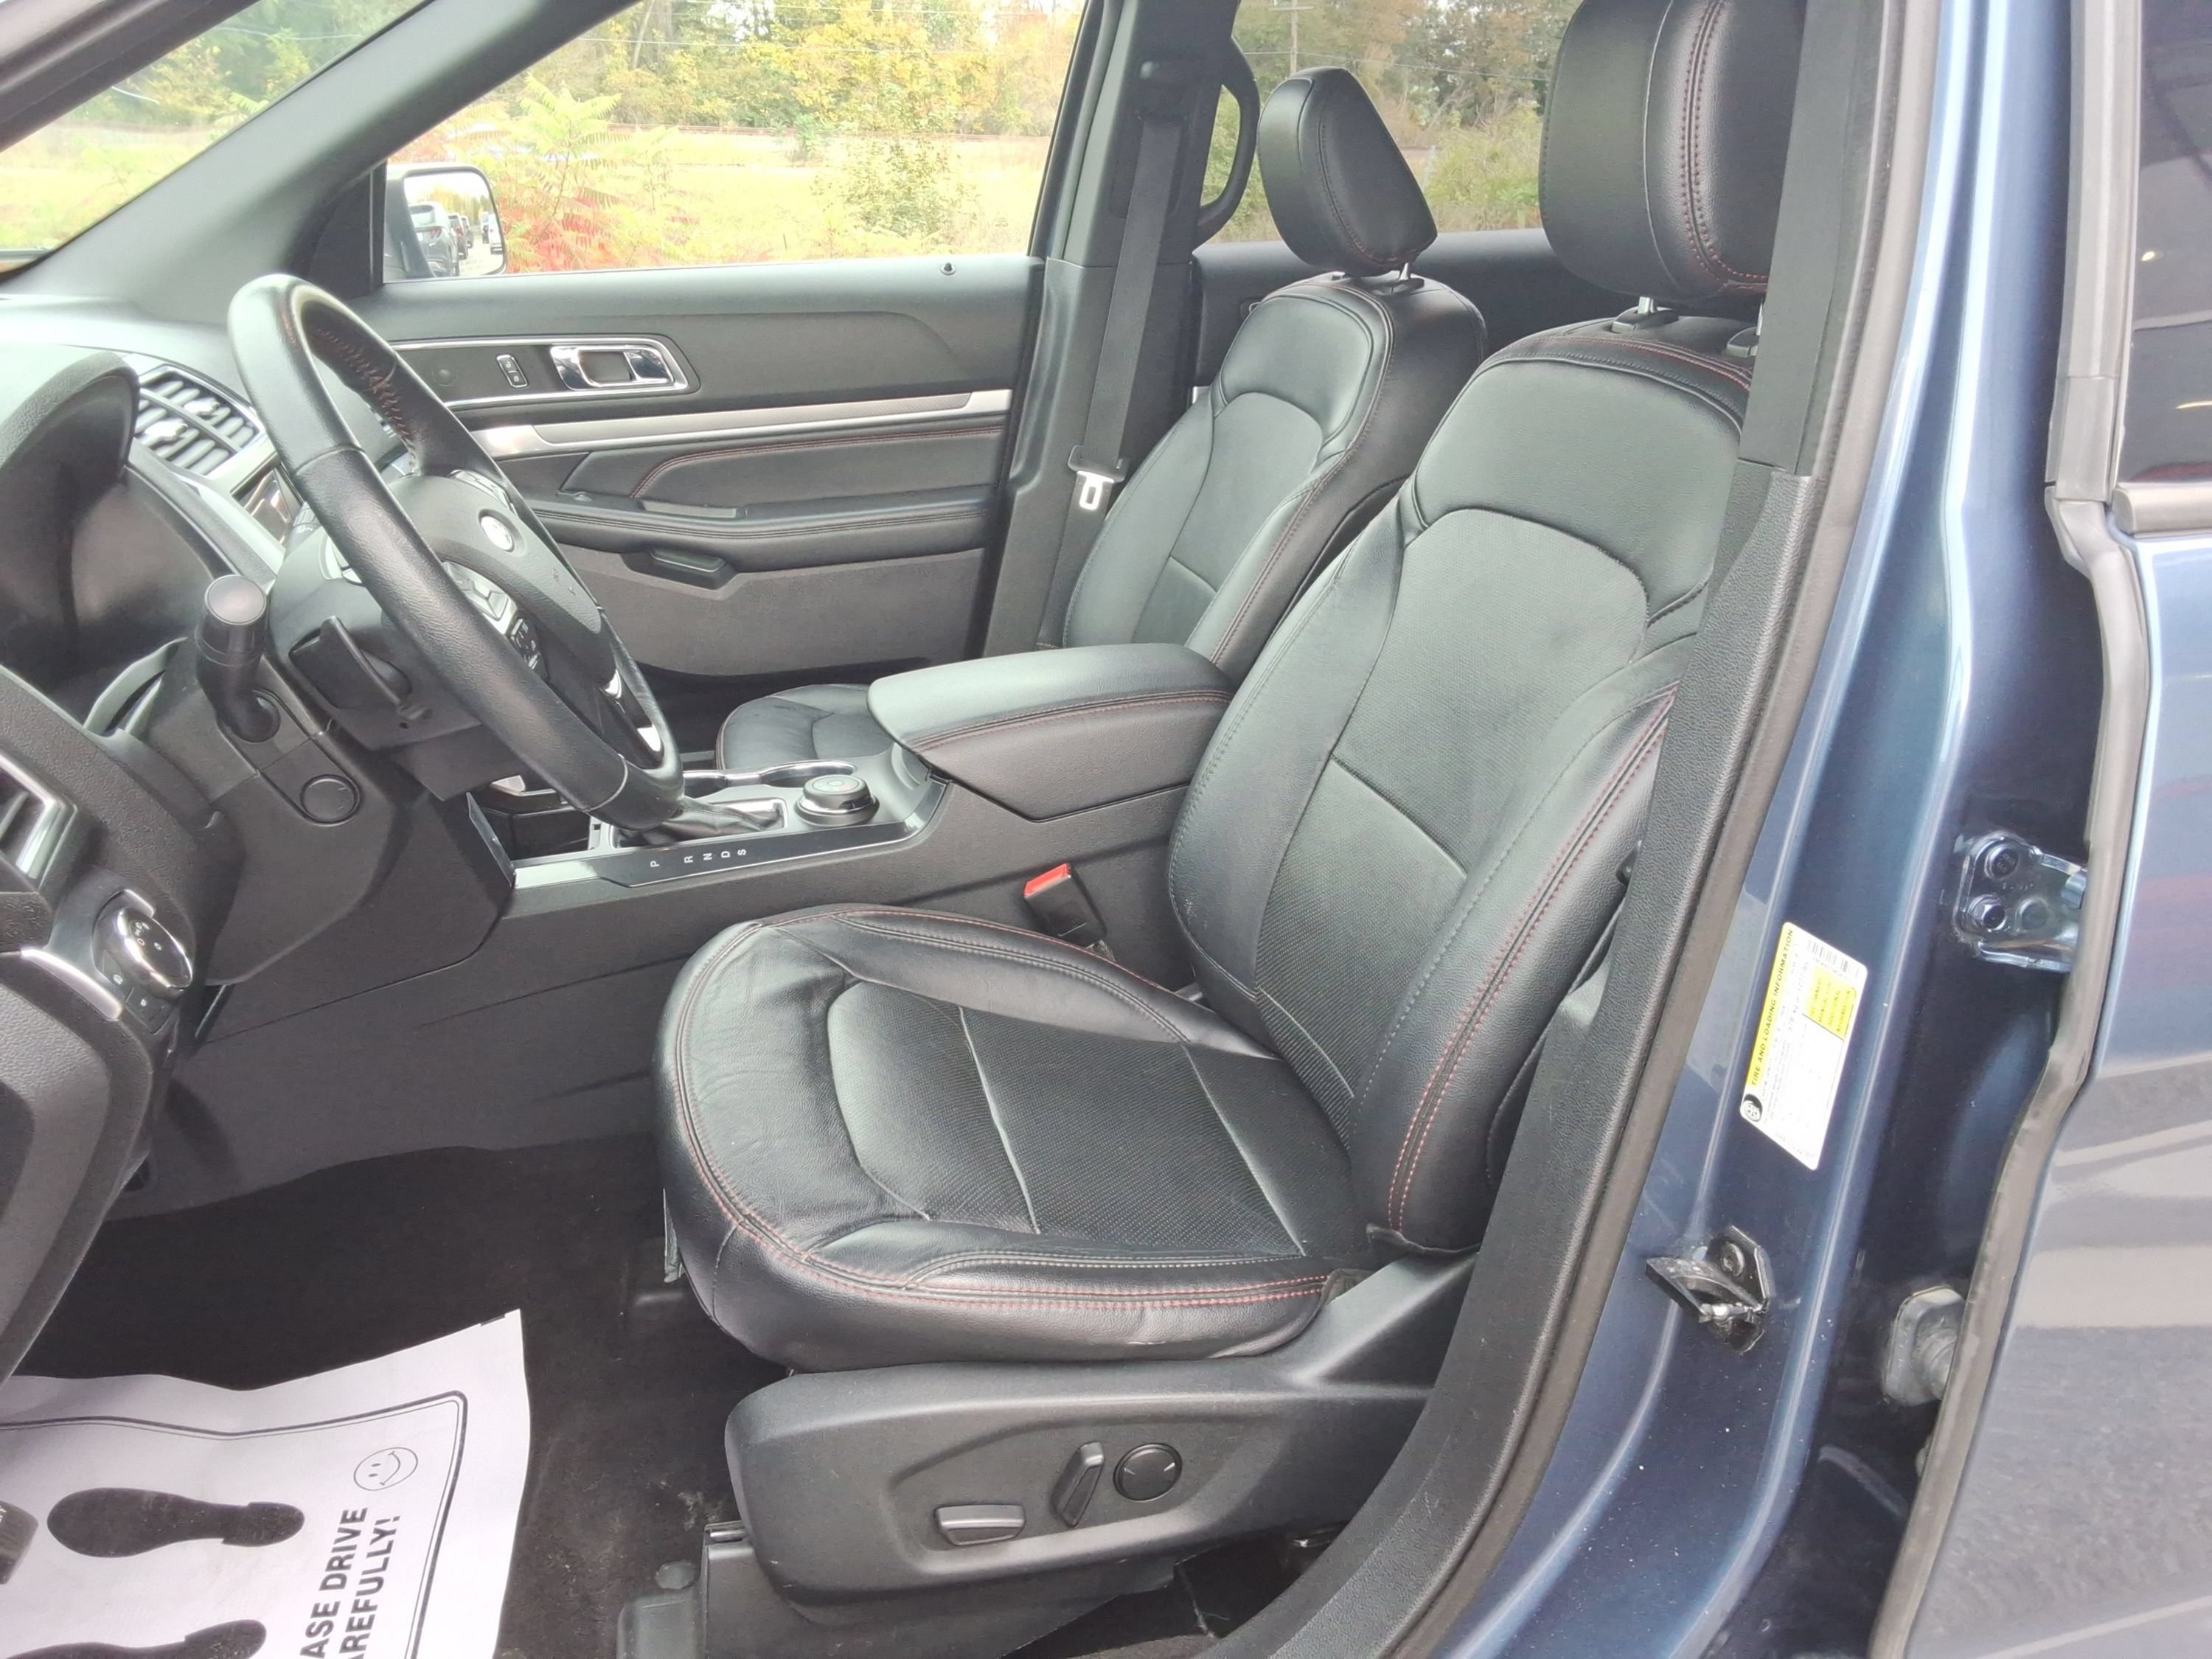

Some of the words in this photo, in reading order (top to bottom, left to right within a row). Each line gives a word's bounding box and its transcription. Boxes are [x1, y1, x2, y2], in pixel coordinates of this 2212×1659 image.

[684, 855, 694, 863] R
[703, 852, 712, 860] N
[720, 850, 731, 859] D
[1751, 1064, 1761, 1087] TIRE
[1757, 1041, 1766, 1063] AND
[1762, 997, 1776, 1042] LOADING
[1773, 928, 1793, 997] INFORMATION
[319, 1508, 368, 1591] DRIVE
[338, 1516, 400, 1659] REFULLY!
